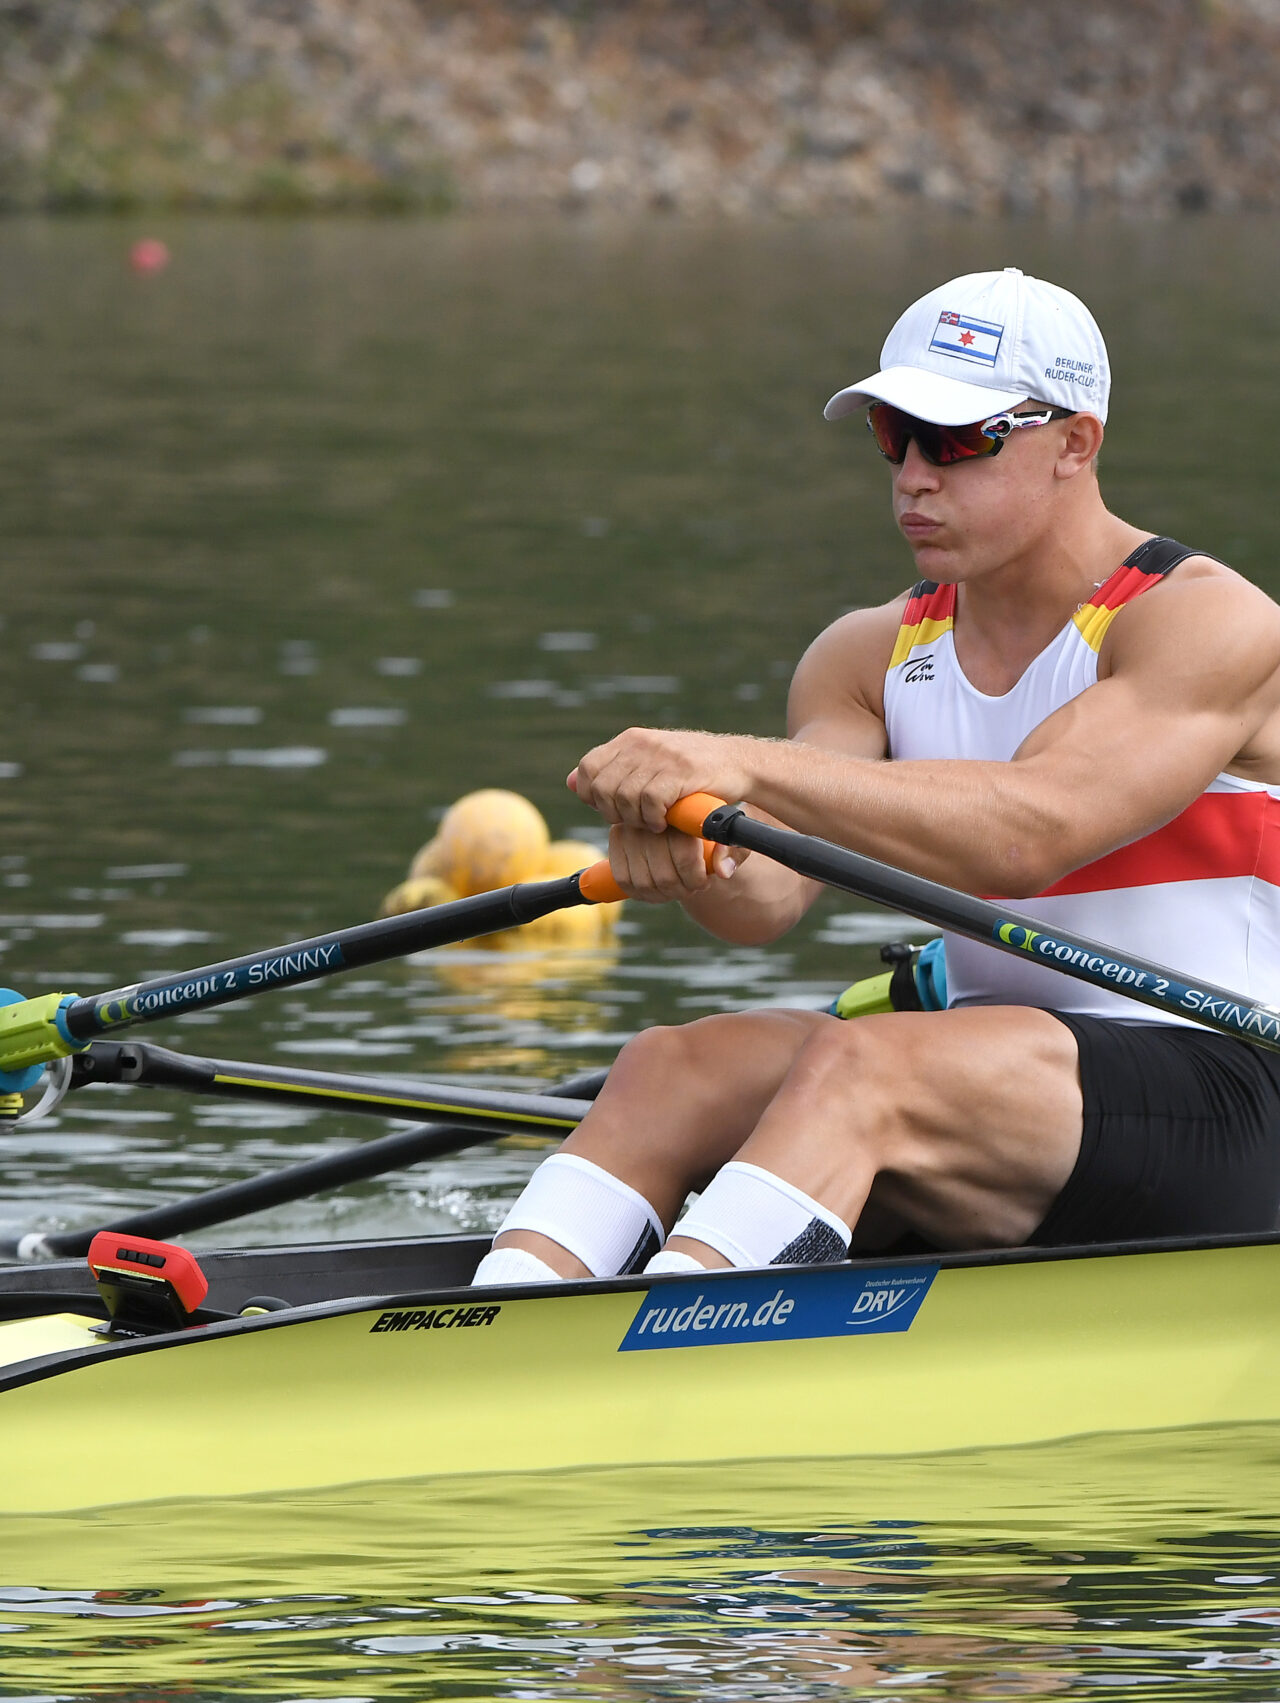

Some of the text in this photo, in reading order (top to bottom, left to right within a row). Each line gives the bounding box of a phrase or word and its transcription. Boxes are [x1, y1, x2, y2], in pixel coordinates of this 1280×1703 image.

[1055, 357, 1093, 374] BERLINER
[132, 944, 336, 1013] concept 2 SKINNY
[1039, 940, 1148, 988] concept
[1152, 978, 1171, 997] 2
[638, 1290, 795, 1334] rudern.de
[852, 1288, 906, 1313] DRV
[369, 1305, 502, 1333] EMPACHER
